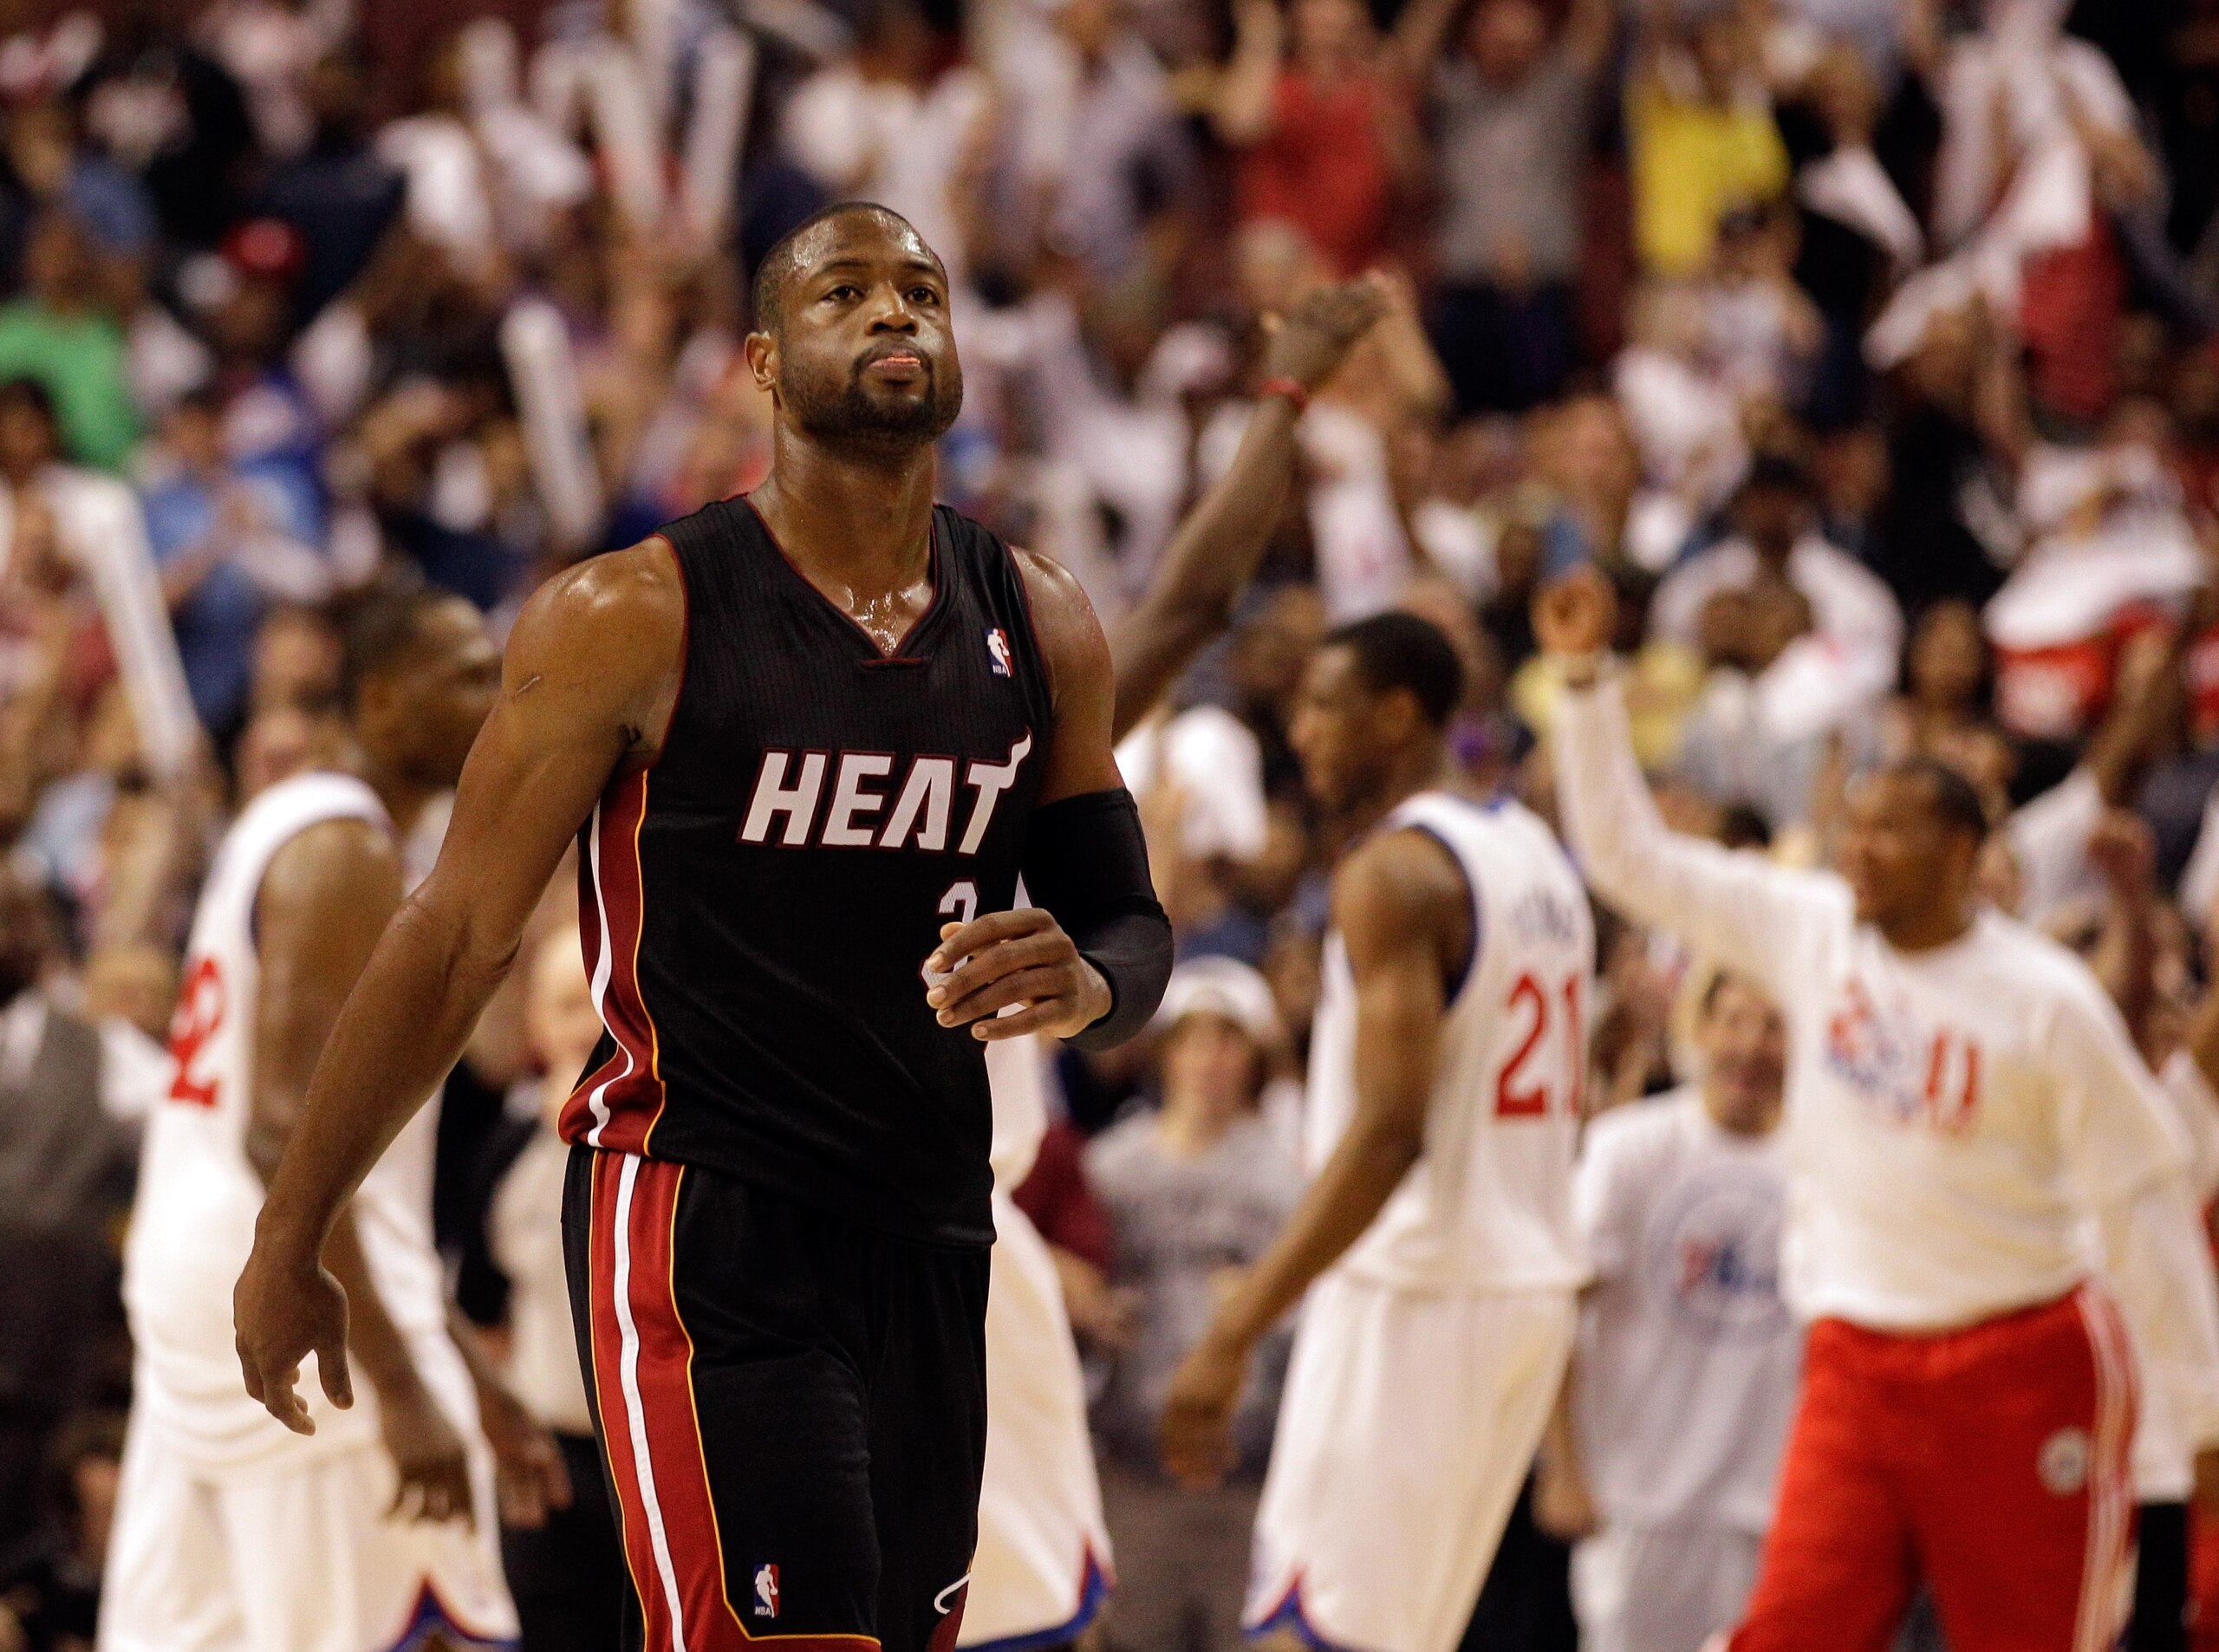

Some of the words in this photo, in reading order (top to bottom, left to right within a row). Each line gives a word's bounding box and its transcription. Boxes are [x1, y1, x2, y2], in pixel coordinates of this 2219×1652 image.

[739, 730, 1032, 855] HEAT
[1494, 971, 1585, 1118] 21
[754, 1606, 771, 1616] NBA
